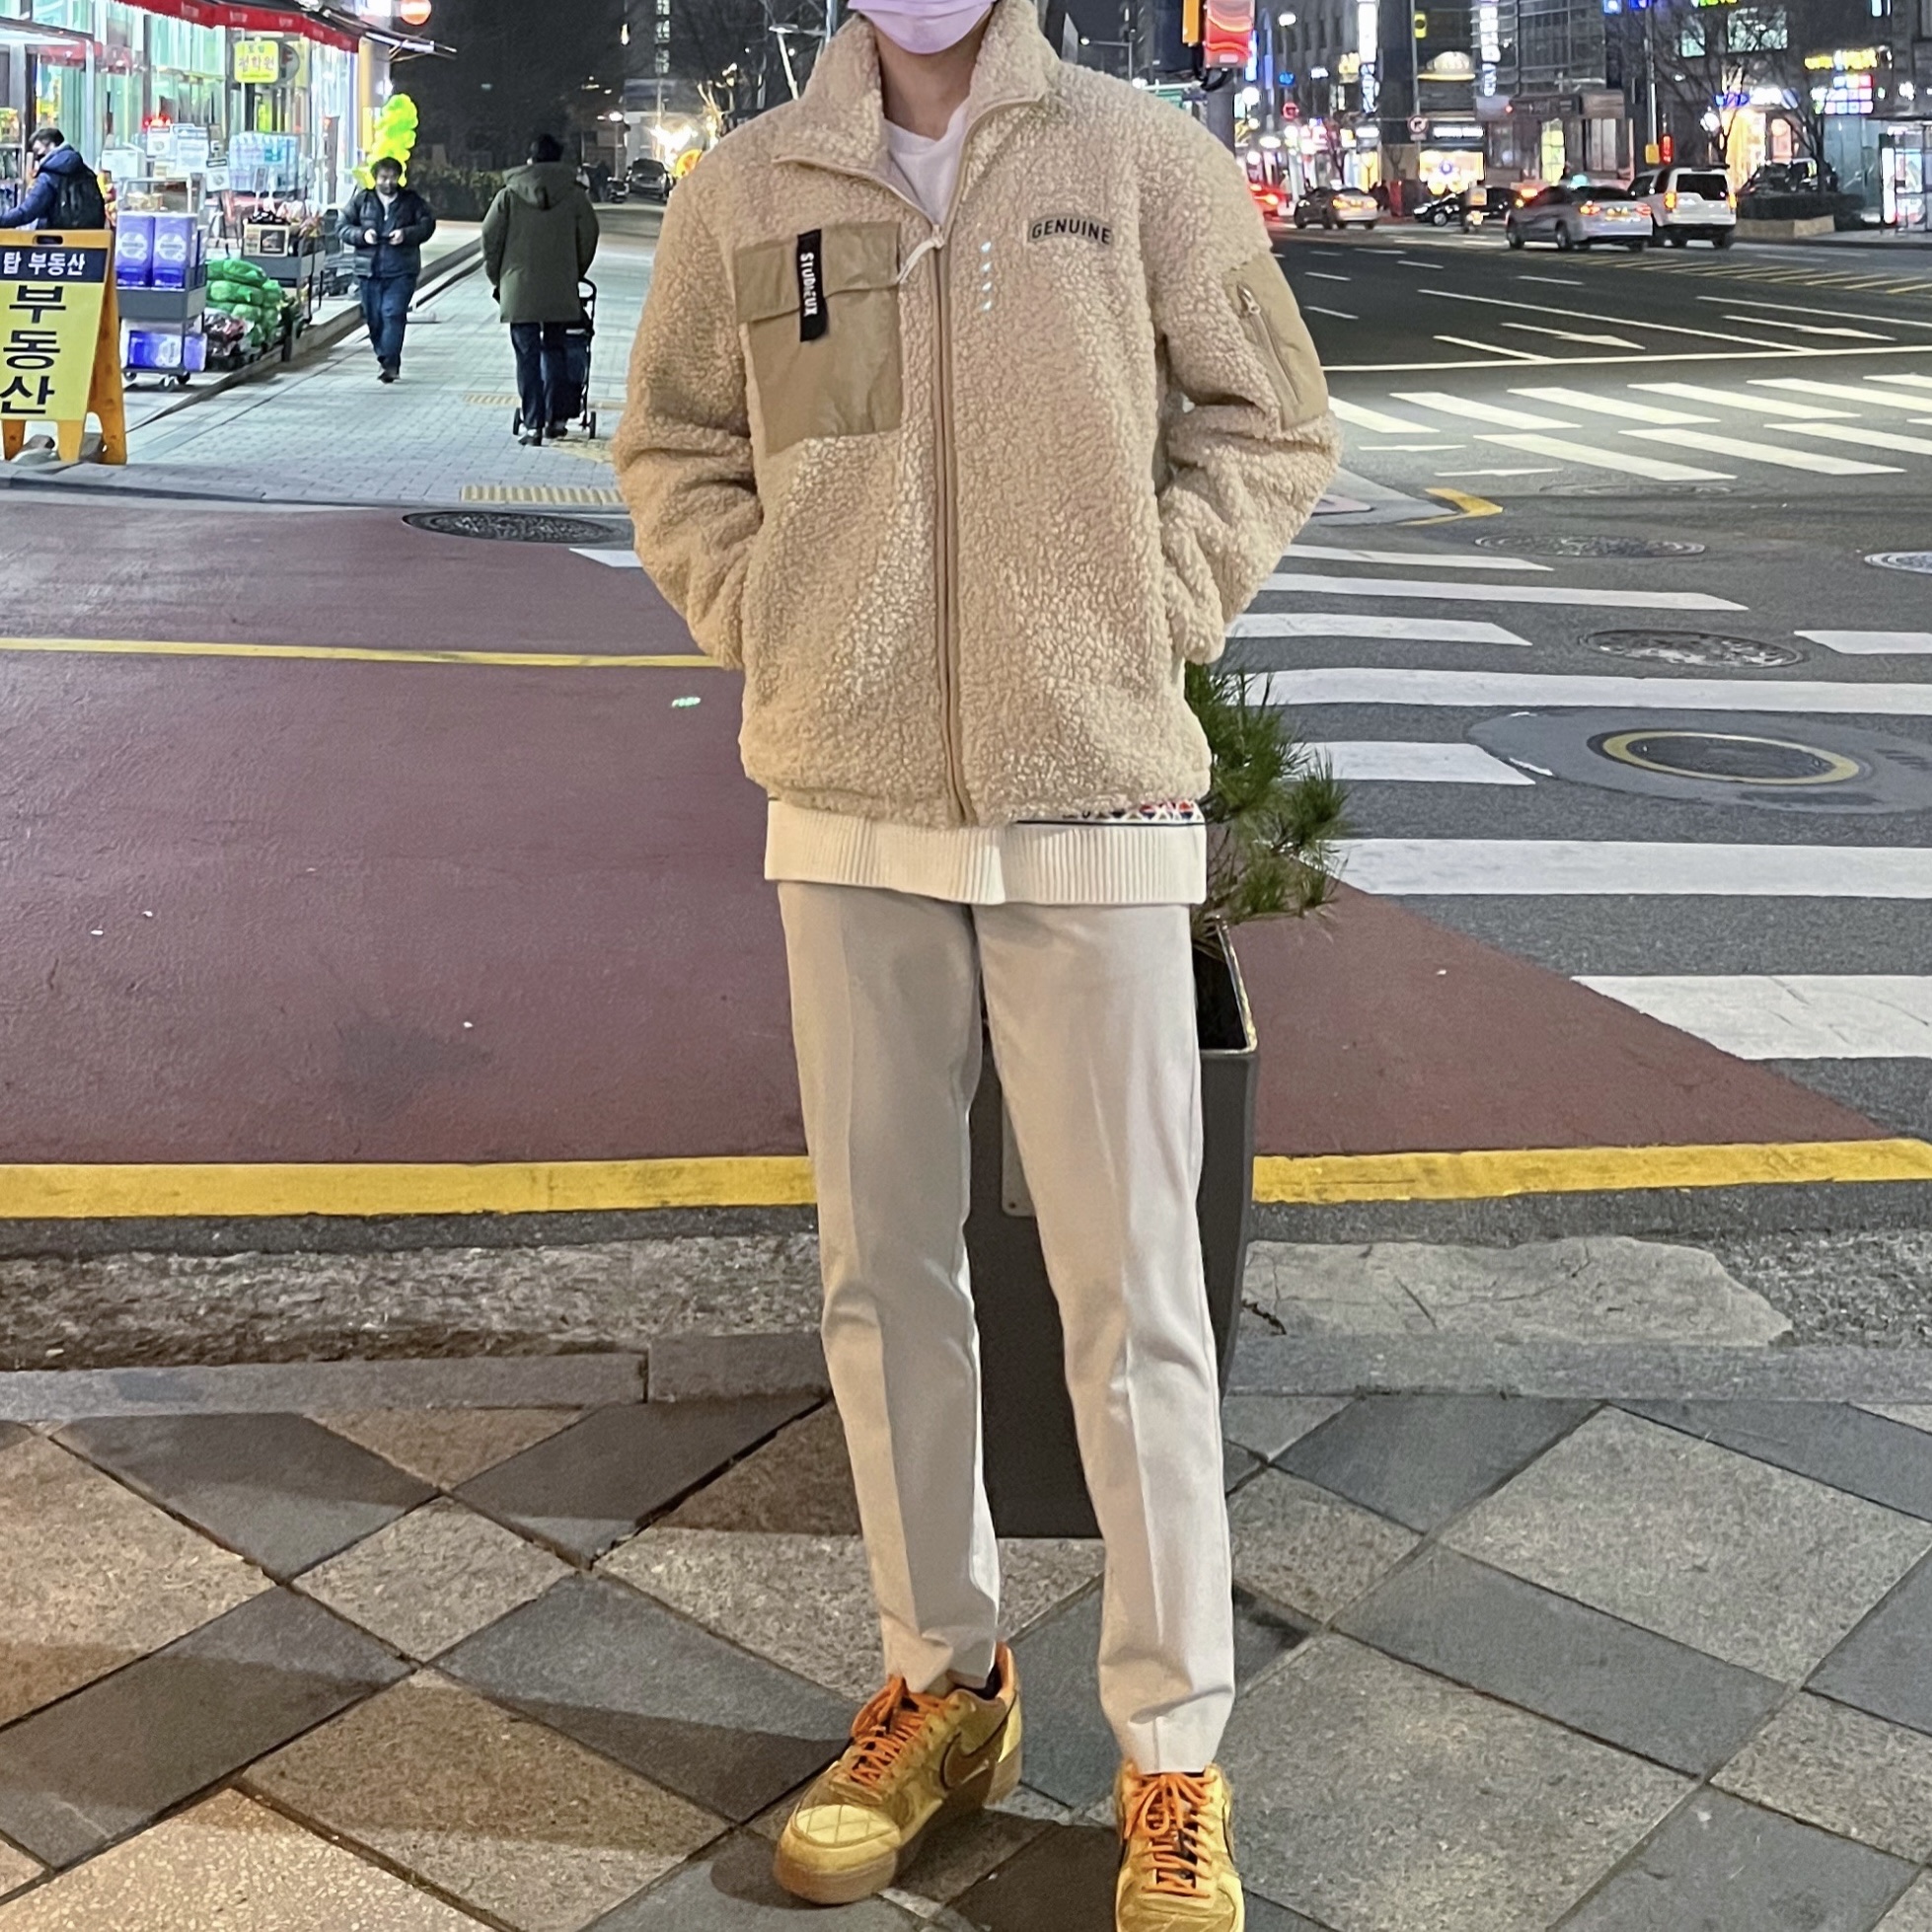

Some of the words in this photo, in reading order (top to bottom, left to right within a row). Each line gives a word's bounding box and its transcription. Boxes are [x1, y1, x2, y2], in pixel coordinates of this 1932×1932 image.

[1031, 218, 1112, 245] GENUINE
[28, 253, 86, 276] 부동산
[0, 284, 67, 414] 부동산
